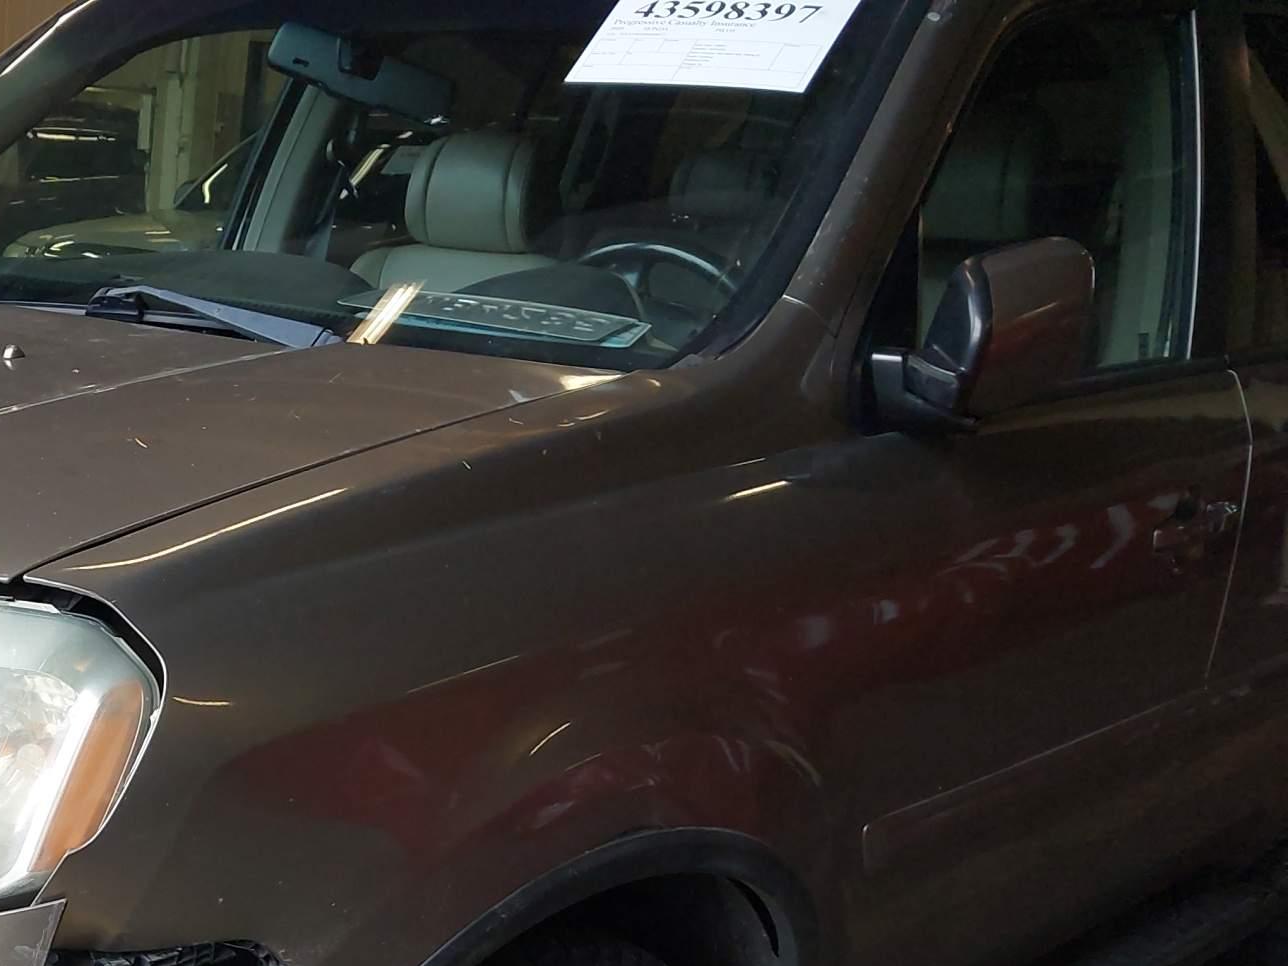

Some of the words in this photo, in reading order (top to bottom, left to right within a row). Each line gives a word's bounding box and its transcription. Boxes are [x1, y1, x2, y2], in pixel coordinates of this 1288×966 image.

[634, 0, 824, 24] 43598397
[613, 18, 667, 27] Progressive
[668, 19, 707, 28] Casualty
[710, 20, 756, 28] Insurance
